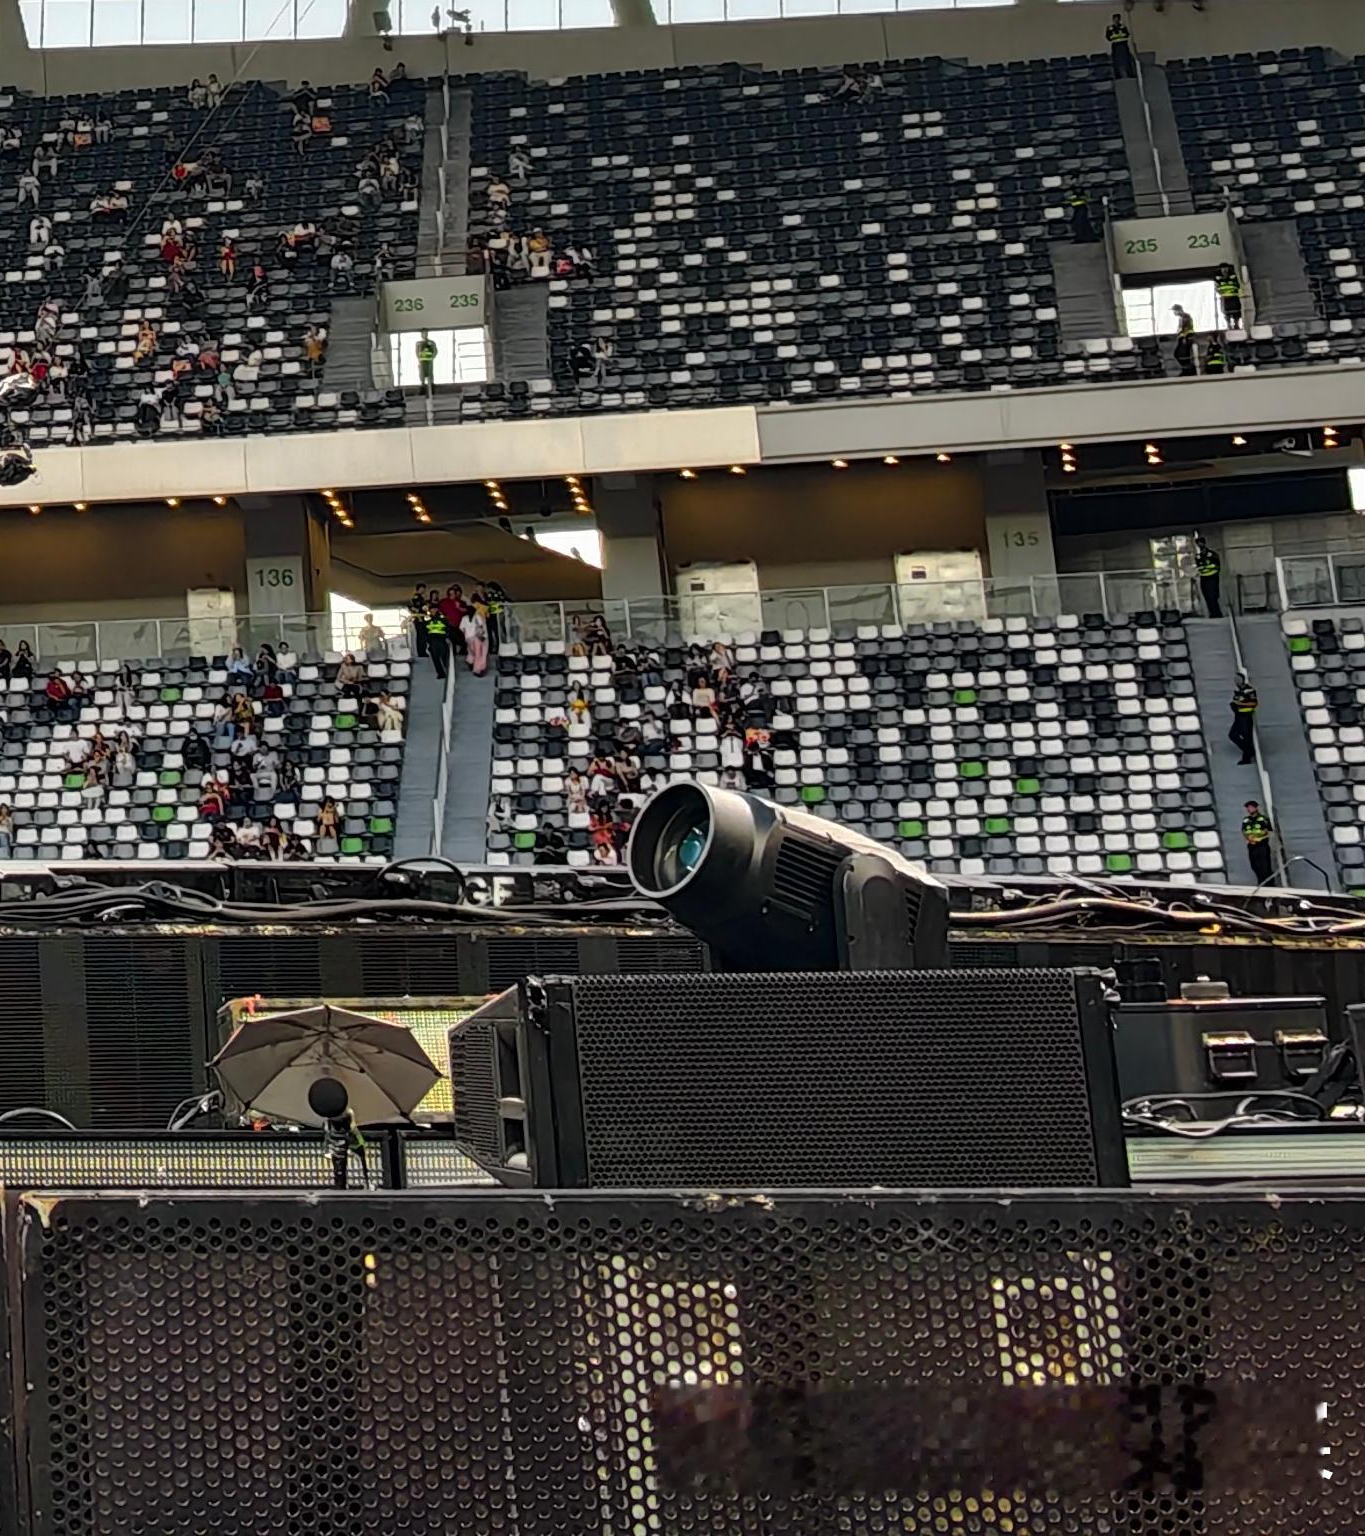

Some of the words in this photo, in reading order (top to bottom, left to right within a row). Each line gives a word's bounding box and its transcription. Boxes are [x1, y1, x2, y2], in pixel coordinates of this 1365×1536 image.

[1126, 238, 1158, 254] 235
[1187, 233, 1221, 249] 234
[394, 298, 425, 313] 236
[449, 294, 479, 308] 235
[1002, 531, 1039, 548] 135
[255, 568, 294, 587] 136
